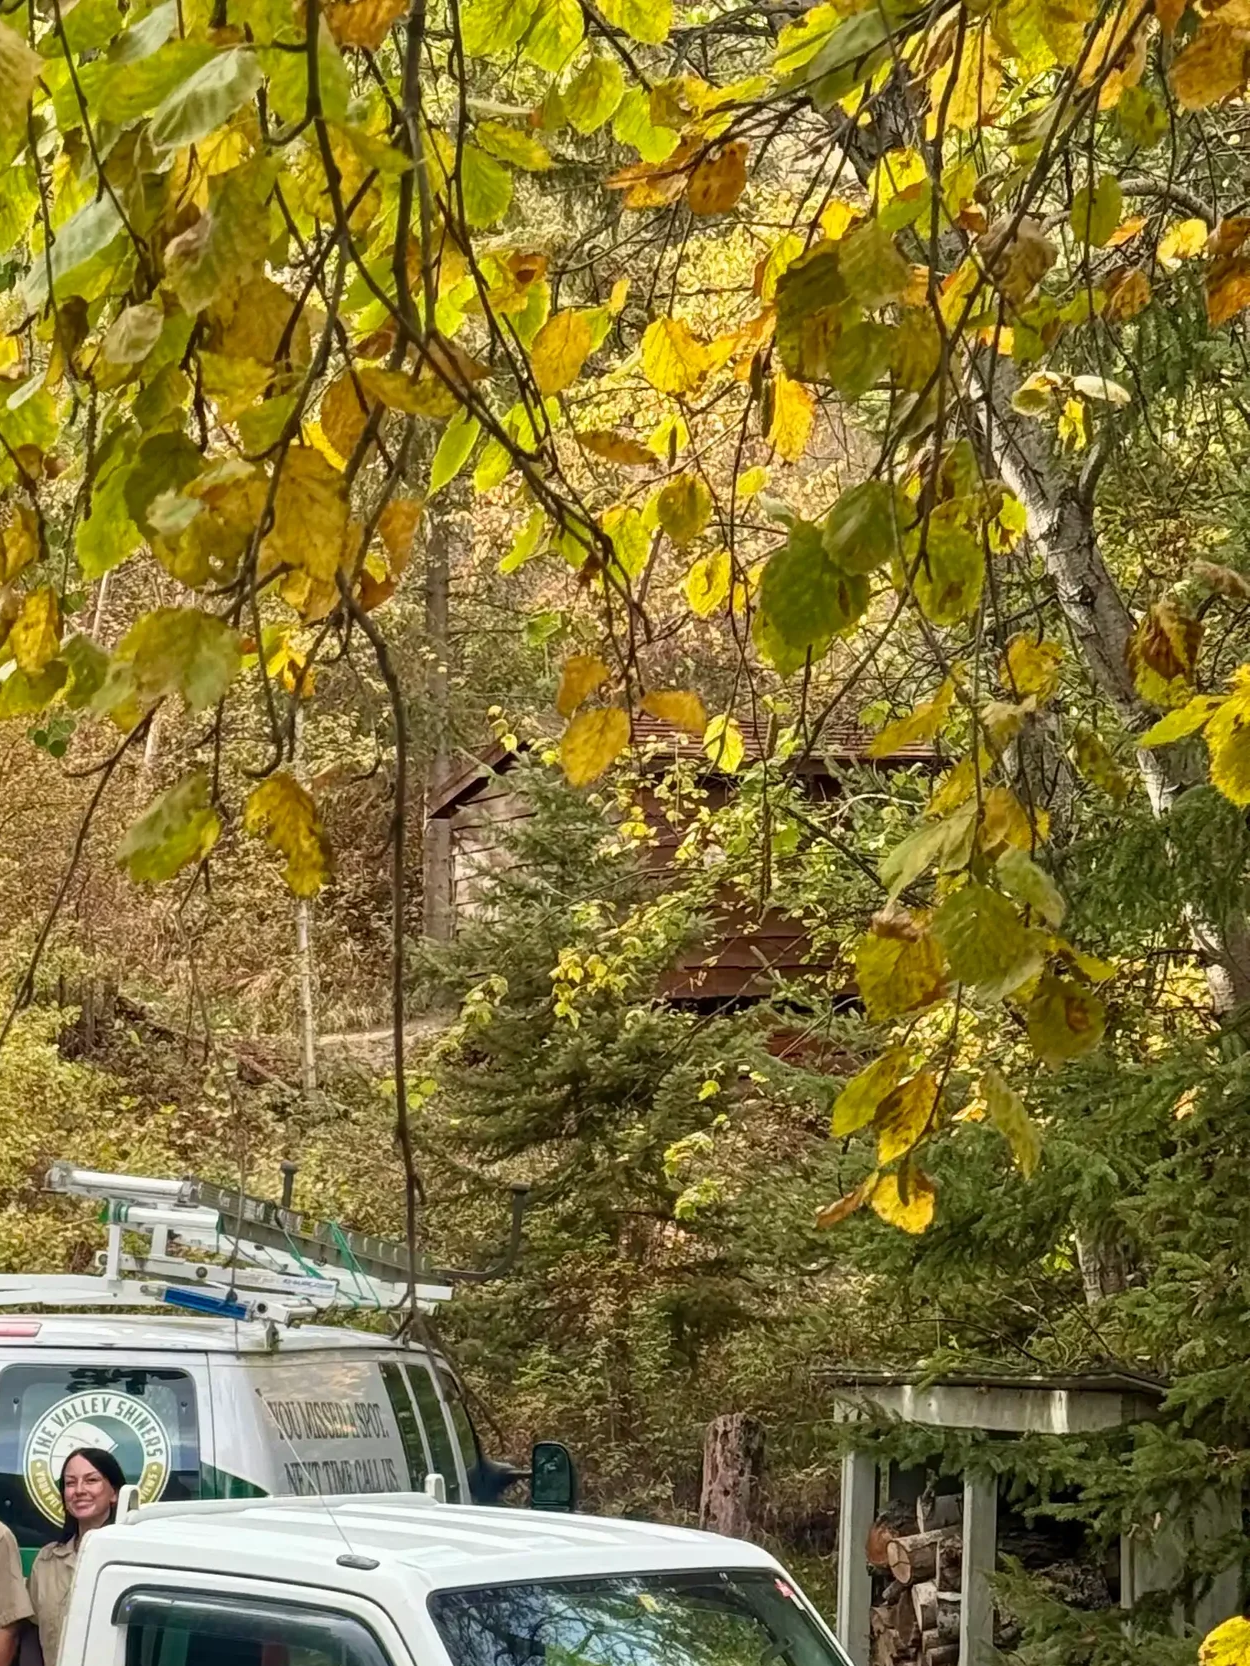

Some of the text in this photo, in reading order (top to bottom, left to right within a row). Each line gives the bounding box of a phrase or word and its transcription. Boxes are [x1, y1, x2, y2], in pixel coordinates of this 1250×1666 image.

[32, 1397, 163, 1459] THE VALLEY SHINERS
[267, 1401, 303, 1440] YOU
[299, 1401, 350, 1439] MISSED
[284, 1461, 321, 1496] NEXT
[321, 1460, 354, 1495] TIME
[354, 1459, 384, 1493] CALL
